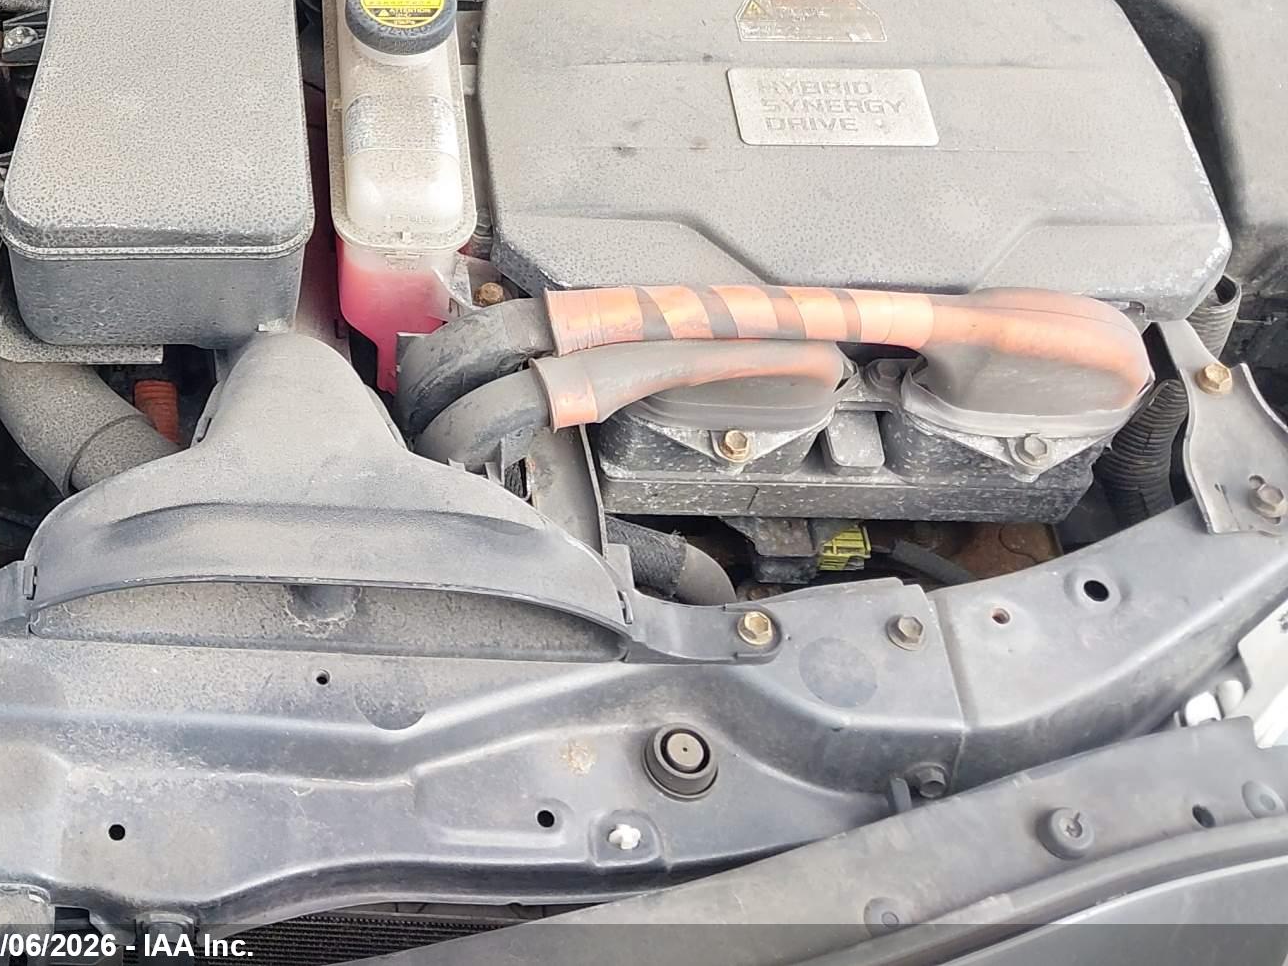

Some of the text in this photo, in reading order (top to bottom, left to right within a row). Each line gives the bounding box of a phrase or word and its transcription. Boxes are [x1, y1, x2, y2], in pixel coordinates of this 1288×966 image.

[758, 81, 872, 95] HYBRID
[762, 98, 906, 115] SYNERGY
[765, 117, 859, 132] DRIVE
